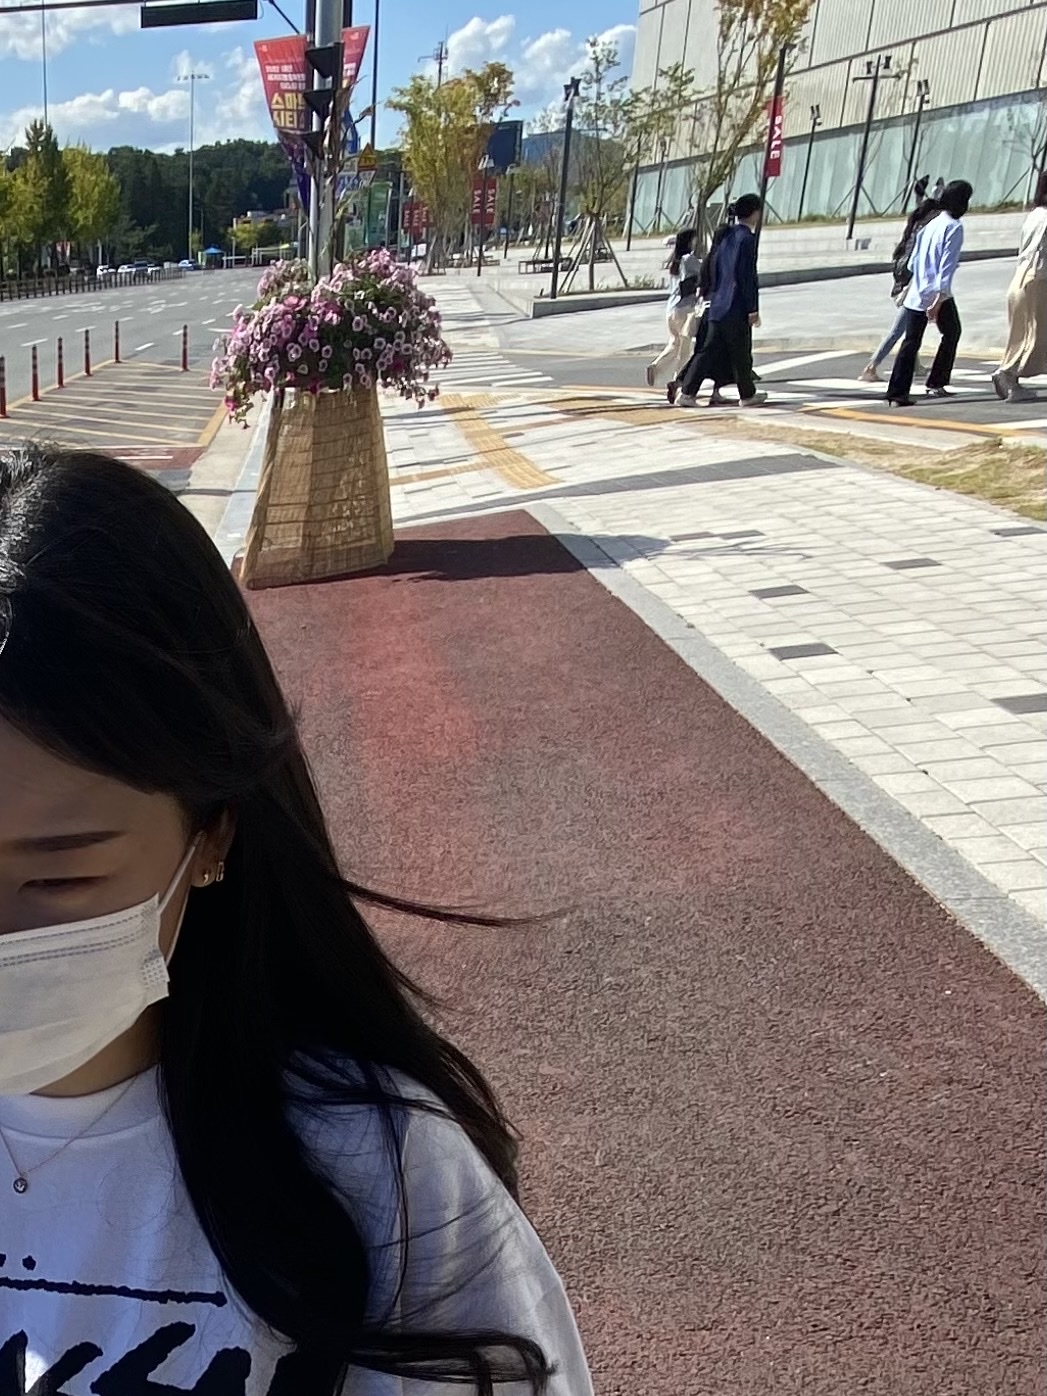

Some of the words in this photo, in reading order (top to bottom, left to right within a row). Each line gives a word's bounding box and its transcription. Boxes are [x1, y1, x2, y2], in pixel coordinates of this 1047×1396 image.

[770, 115, 783, 159] SALE
[472, 189, 482, 214] SALE
[486, 188, 496, 214] SALE
